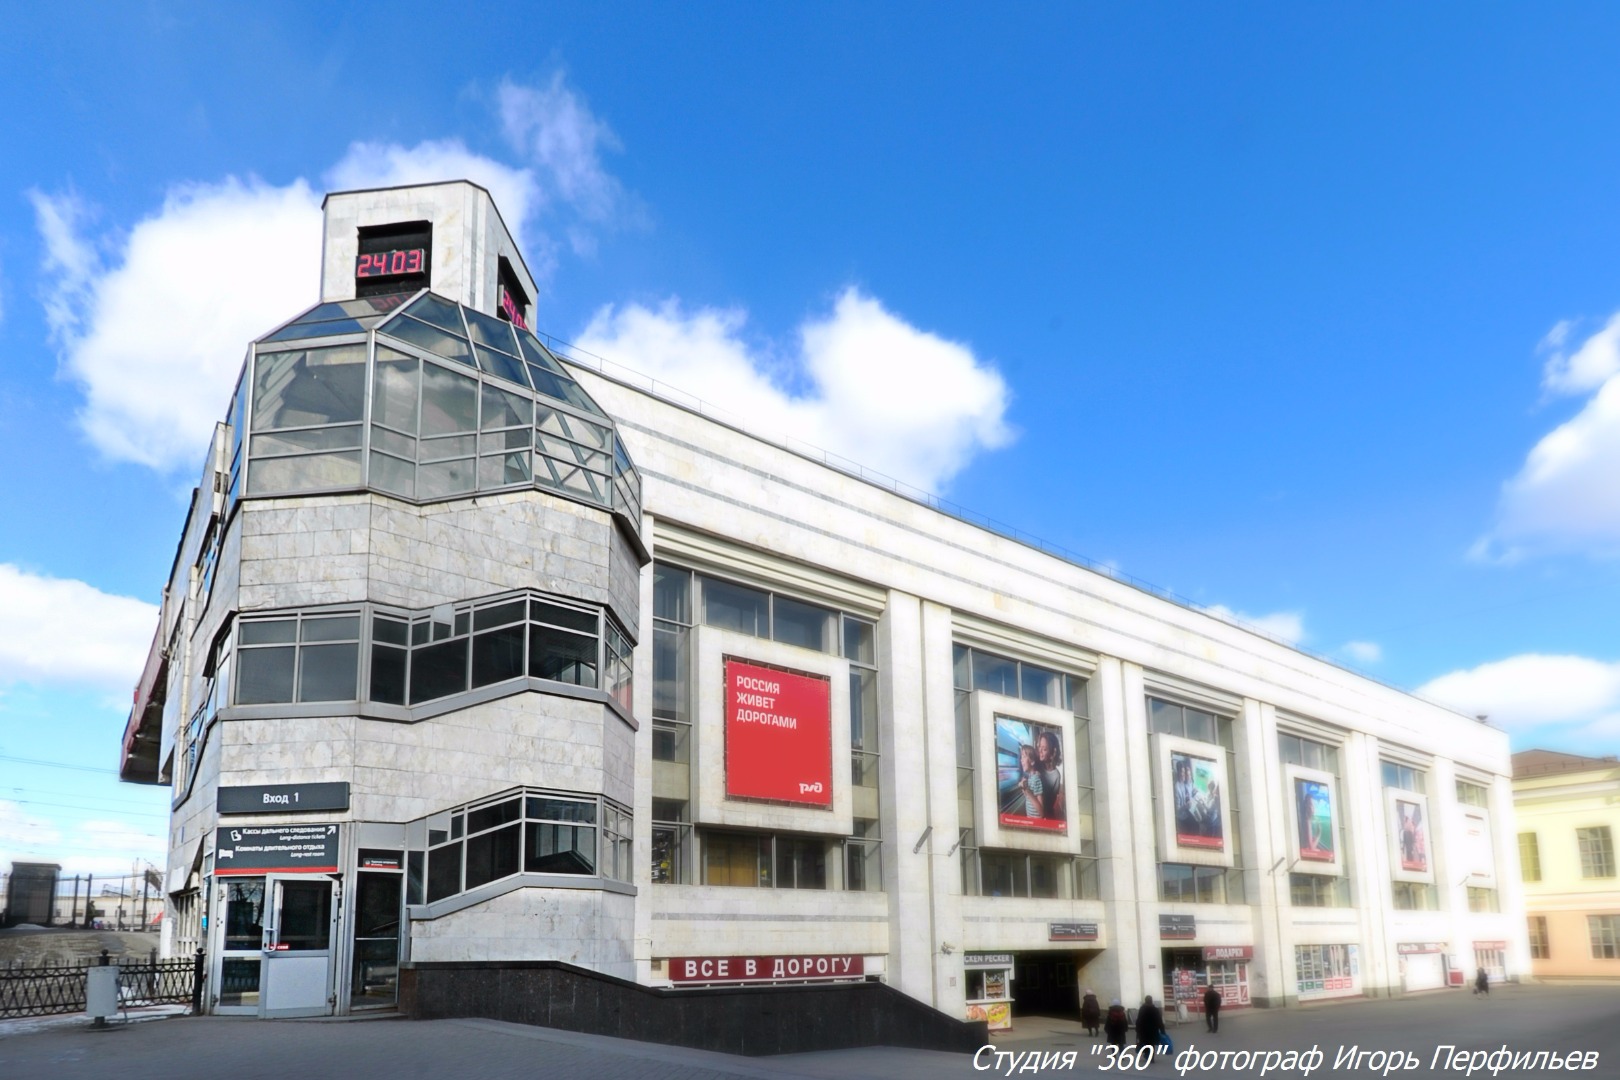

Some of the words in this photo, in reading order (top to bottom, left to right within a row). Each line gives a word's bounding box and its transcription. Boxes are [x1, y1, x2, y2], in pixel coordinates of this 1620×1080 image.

[736, 675, 780, 694] РОССИЯ
[736, 691, 775, 709] ЖИВЕТ
[736, 708, 797, 729] ДОРОГАМИ
[263, 793, 289, 804] Вход
[294, 792, 299, 802] 1
[685, 959, 729, 977] ВСЕ
[745, 960, 757, 975] В
[773, 957, 852, 977] ДОРОГУ
